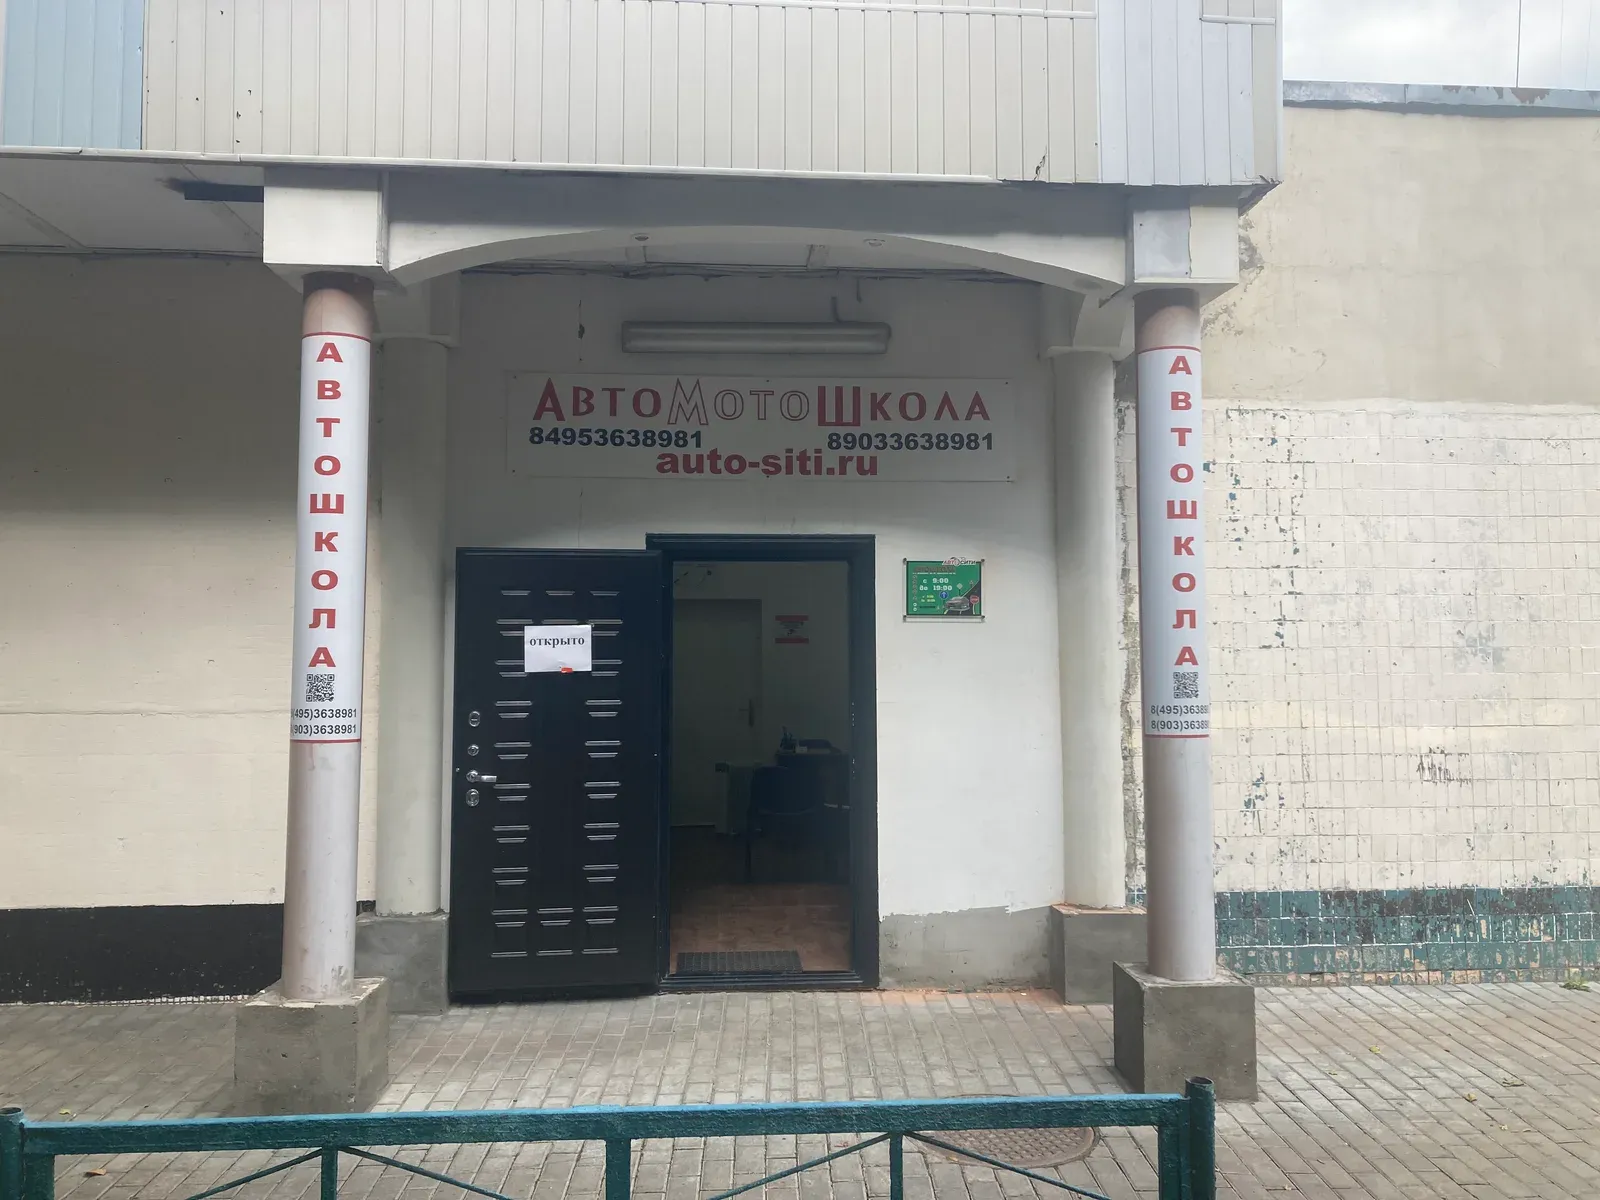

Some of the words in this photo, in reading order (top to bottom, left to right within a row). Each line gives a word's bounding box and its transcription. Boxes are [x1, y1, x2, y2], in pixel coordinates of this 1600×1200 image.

[528, 426, 703, 449] 84953638981
[827, 432, 993, 450] 89033638981
[655, 447, 879, 475] auto-siti.ru
[308, 342, 345, 668] АВТОШКОЛА
[1166, 355, 1199, 666] АВТОШКОЛА
[529, 636, 585, 648] открыто
